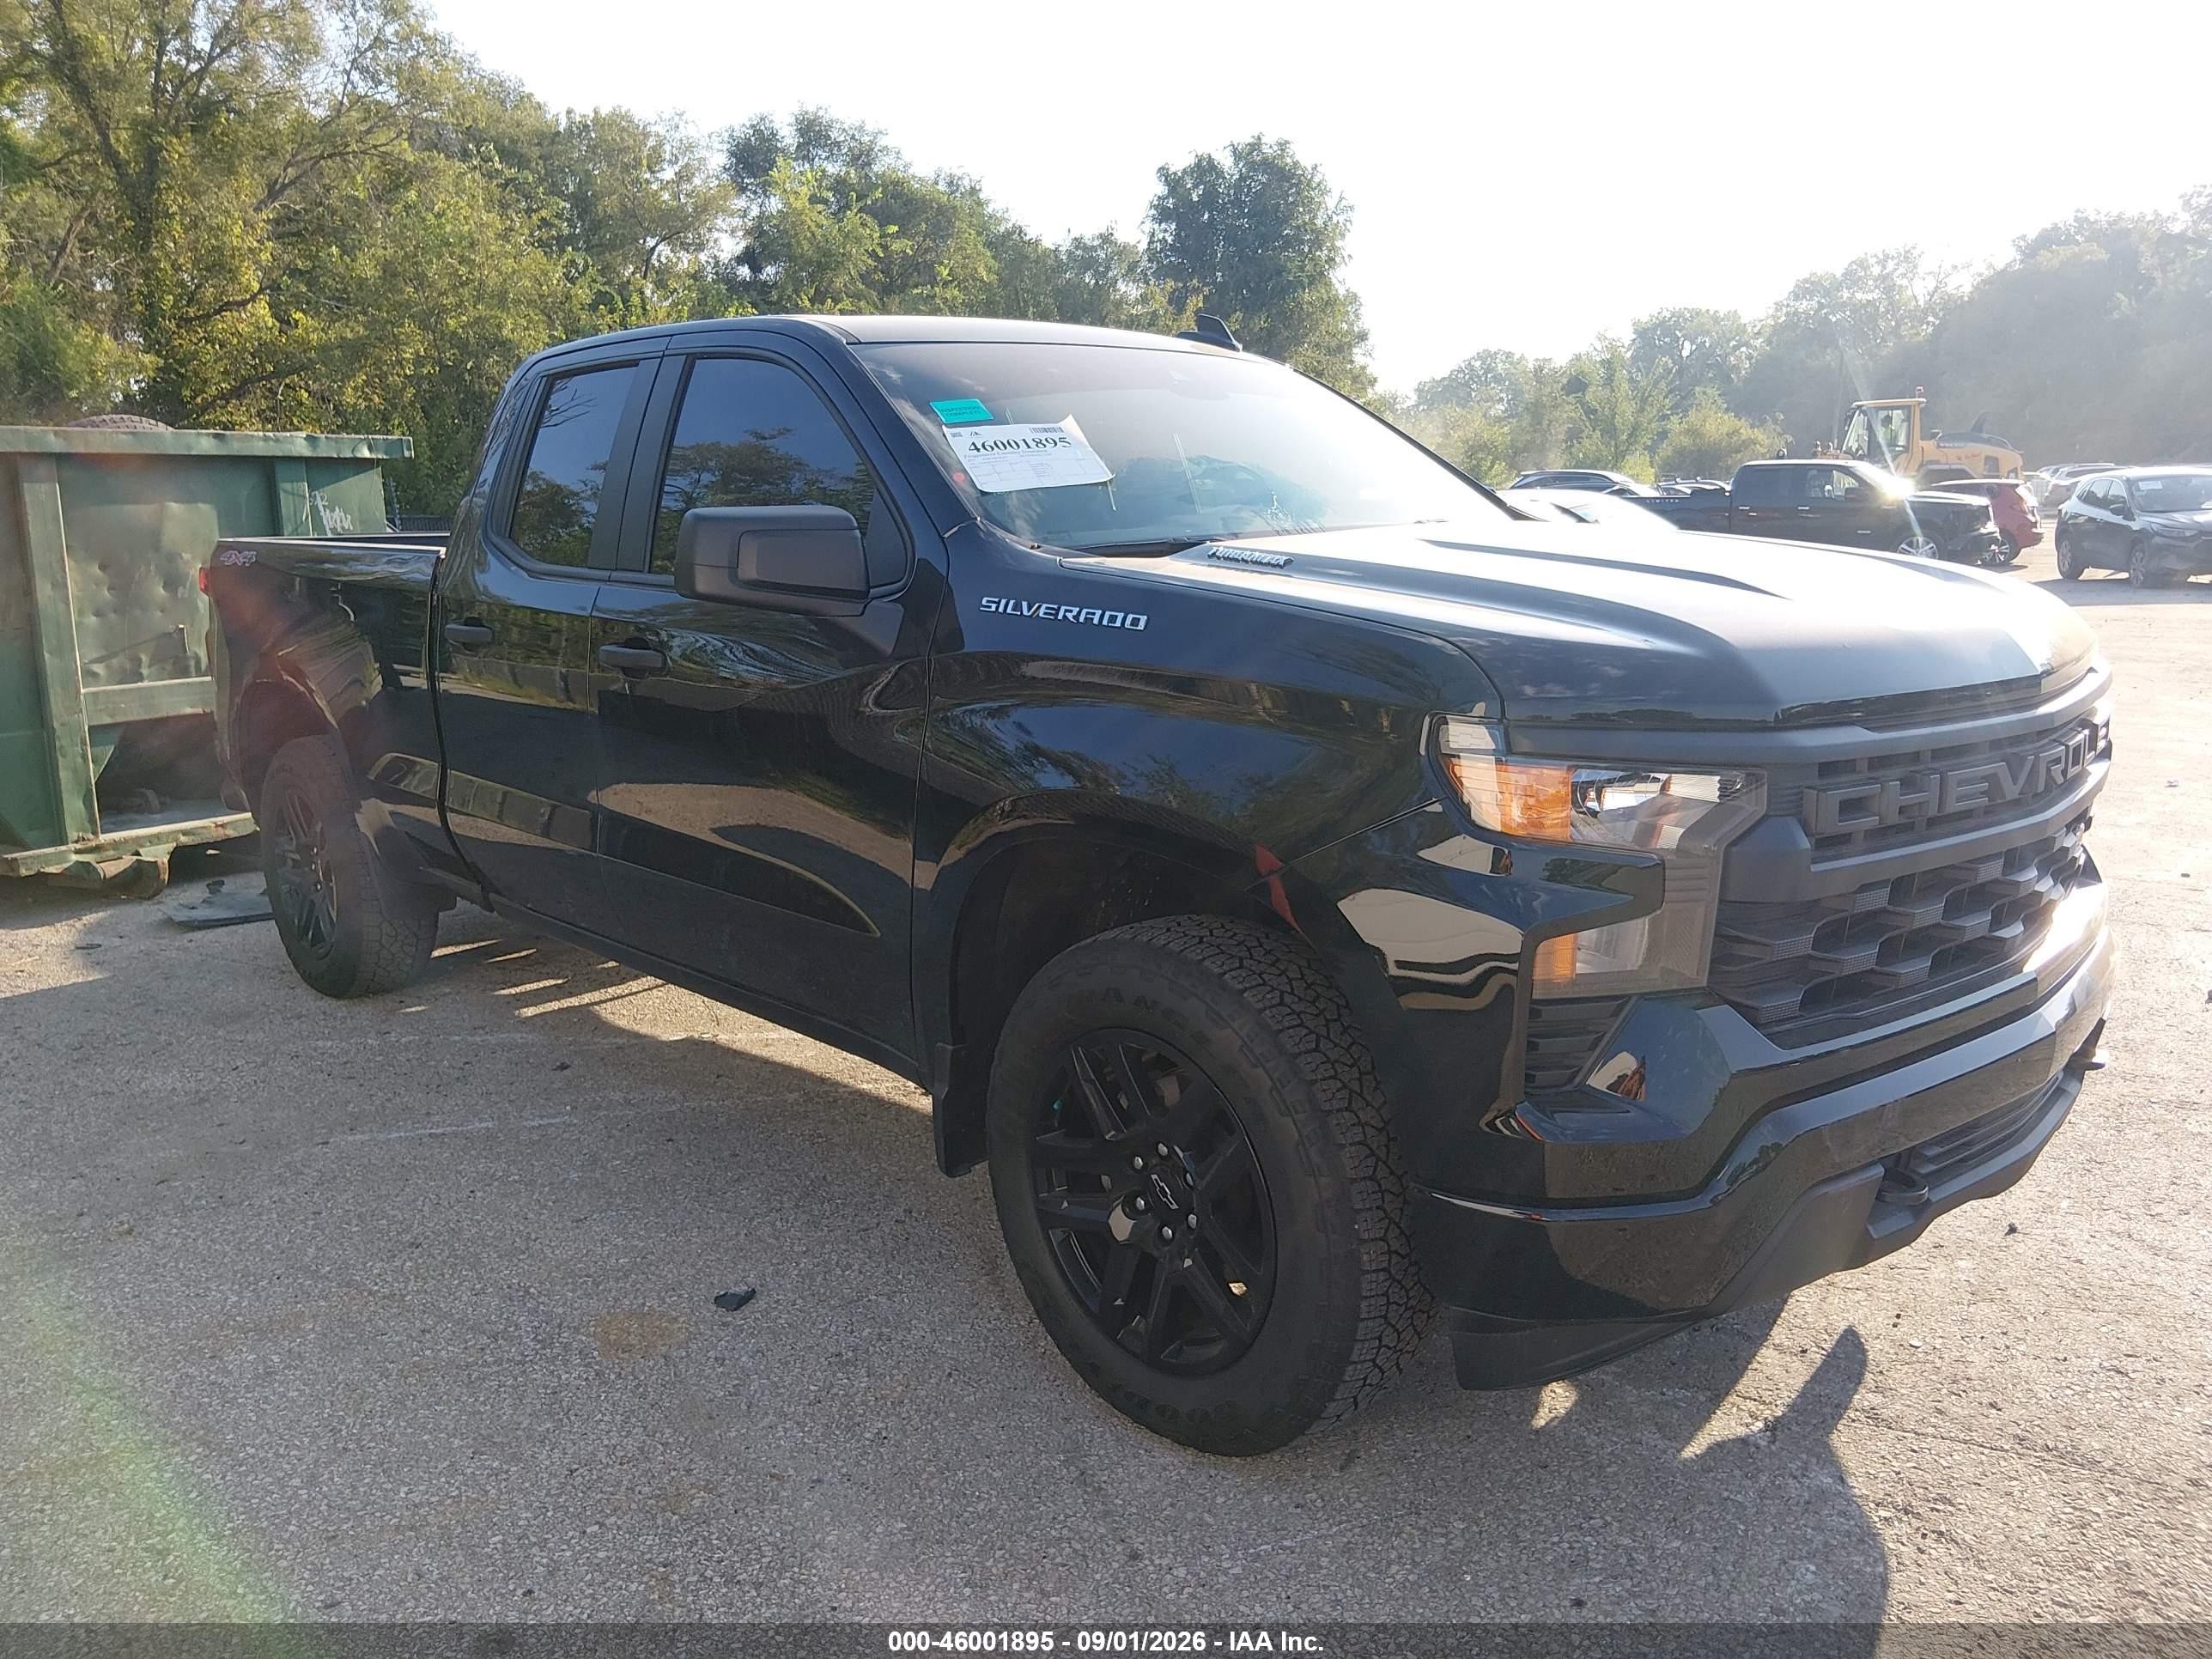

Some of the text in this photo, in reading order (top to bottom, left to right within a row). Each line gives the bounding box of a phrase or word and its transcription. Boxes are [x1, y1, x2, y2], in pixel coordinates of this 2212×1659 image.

[968, 437, 1072, 453] 46001895
[979, 596, 1148, 631] SILVERADO
[1806, 720, 2111, 836] CHEVROLE
